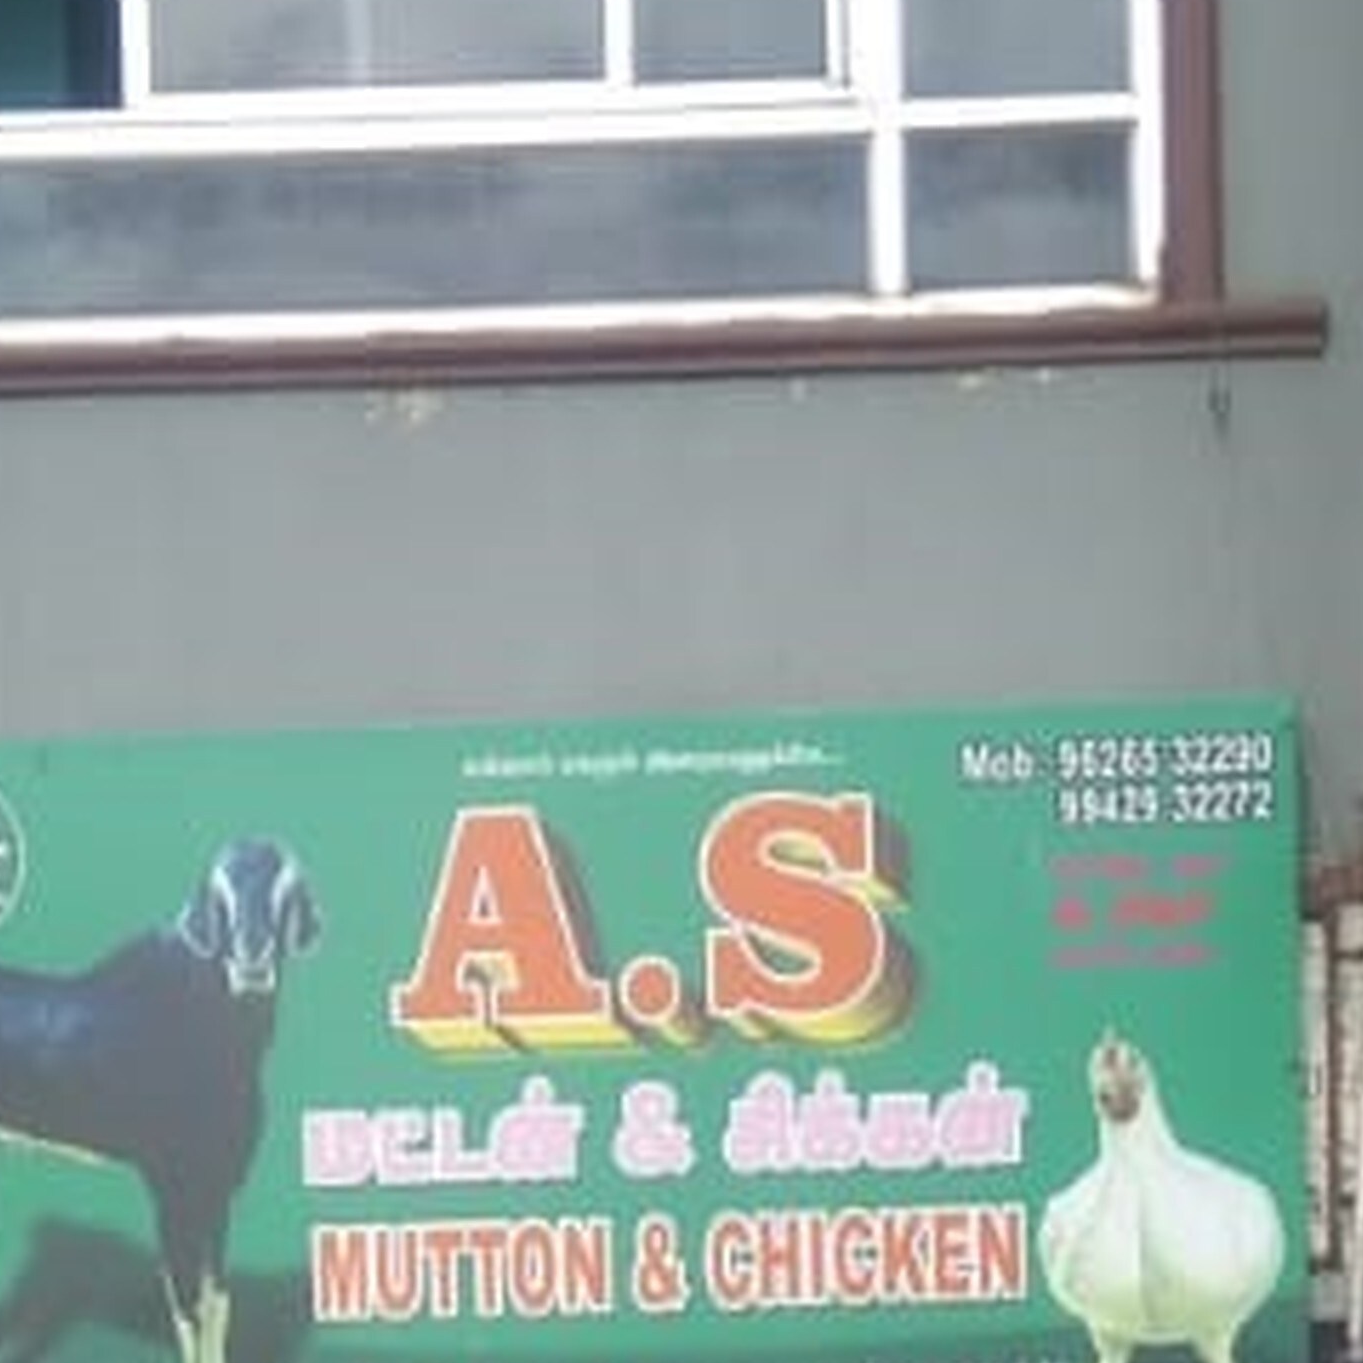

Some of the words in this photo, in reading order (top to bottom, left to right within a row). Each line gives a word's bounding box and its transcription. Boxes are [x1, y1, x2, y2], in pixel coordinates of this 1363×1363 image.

[391, 788, 914, 1054] A.S
[302, 1076, 585, 1186] மட்டன்
[614, 1081, 696, 1177] &
[723, 1061, 1029, 1173] சிக்கன்
[312, 1217, 613, 1322] MUTTON
[636, 1213, 691, 1313] &
[703, 1203, 1027, 1309] CHICKEN
